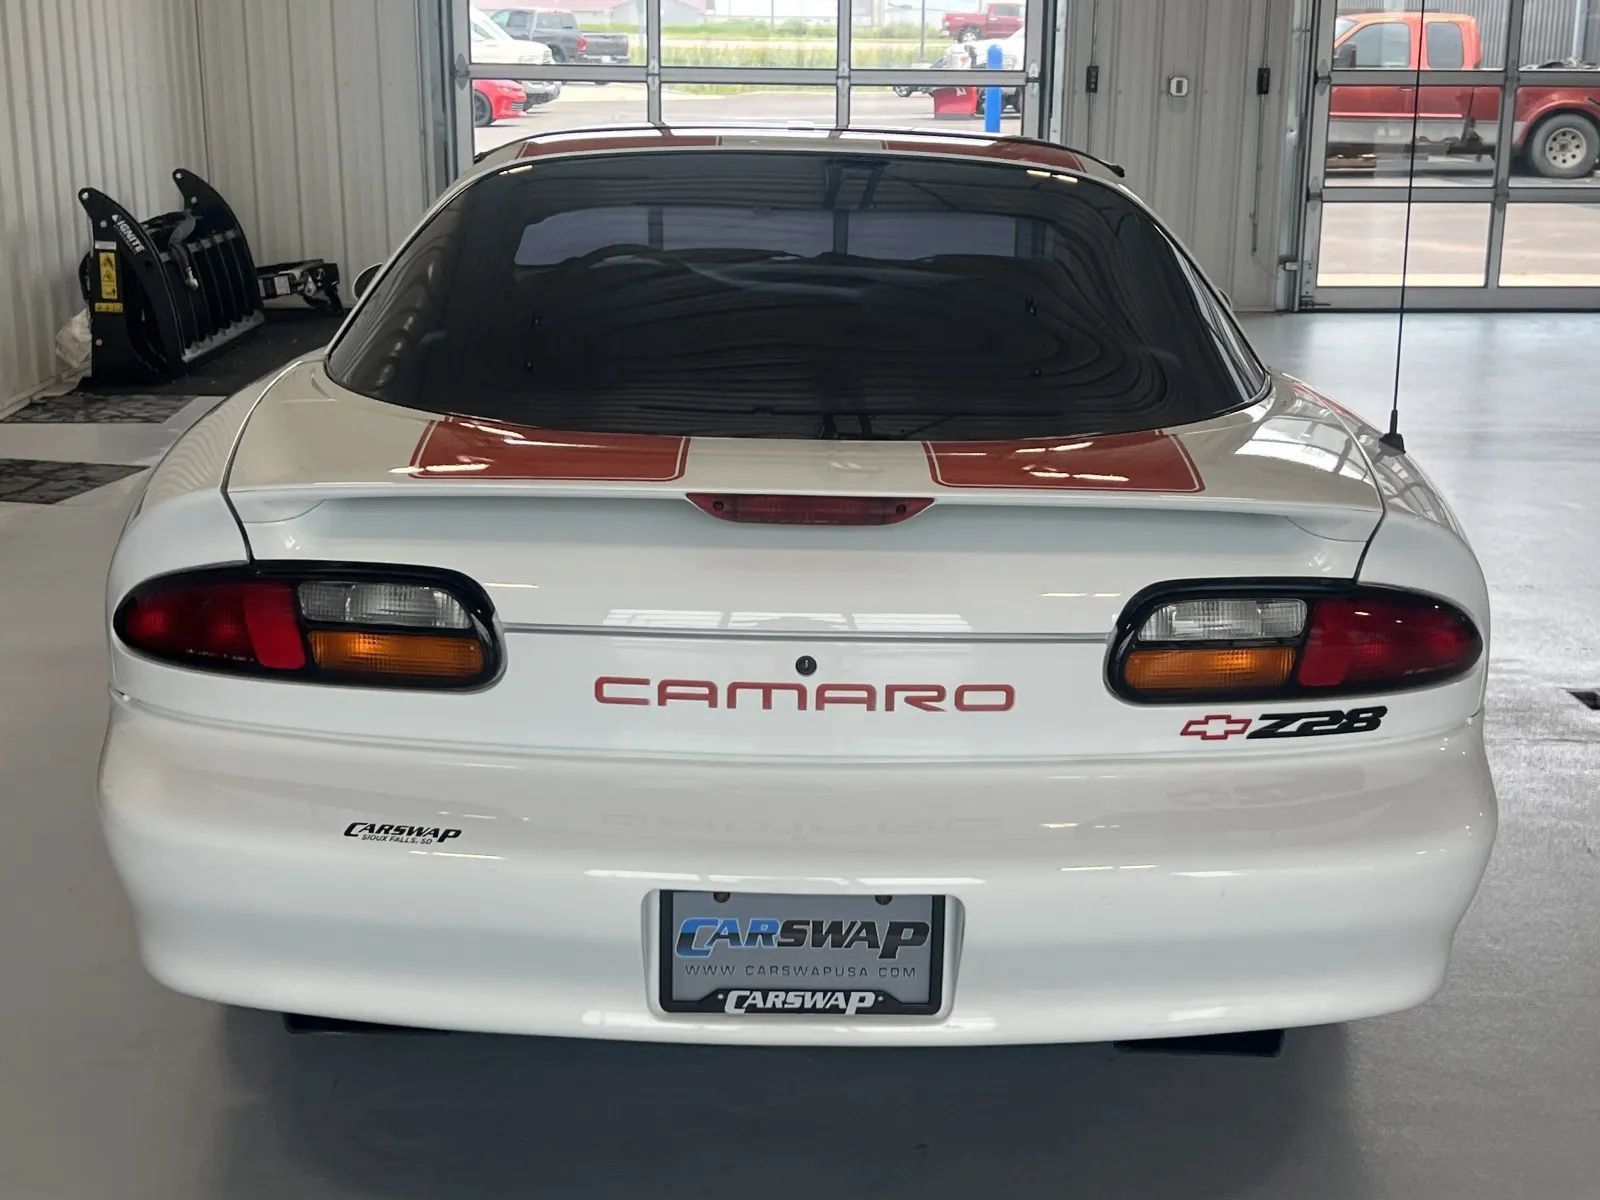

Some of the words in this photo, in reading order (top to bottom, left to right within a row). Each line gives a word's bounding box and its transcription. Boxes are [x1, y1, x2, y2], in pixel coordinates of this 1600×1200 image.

[116, 220, 145, 253] IGNITE
[594, 676, 1016, 712] CAMARO
[1246, 705, 1388, 740] Z28
[343, 822, 462, 843] CARSWAP
[361, 834, 388, 842] SIOUX
[675, 917, 931, 960] CARSWAP
[724, 989, 876, 1015] CARSWAP
